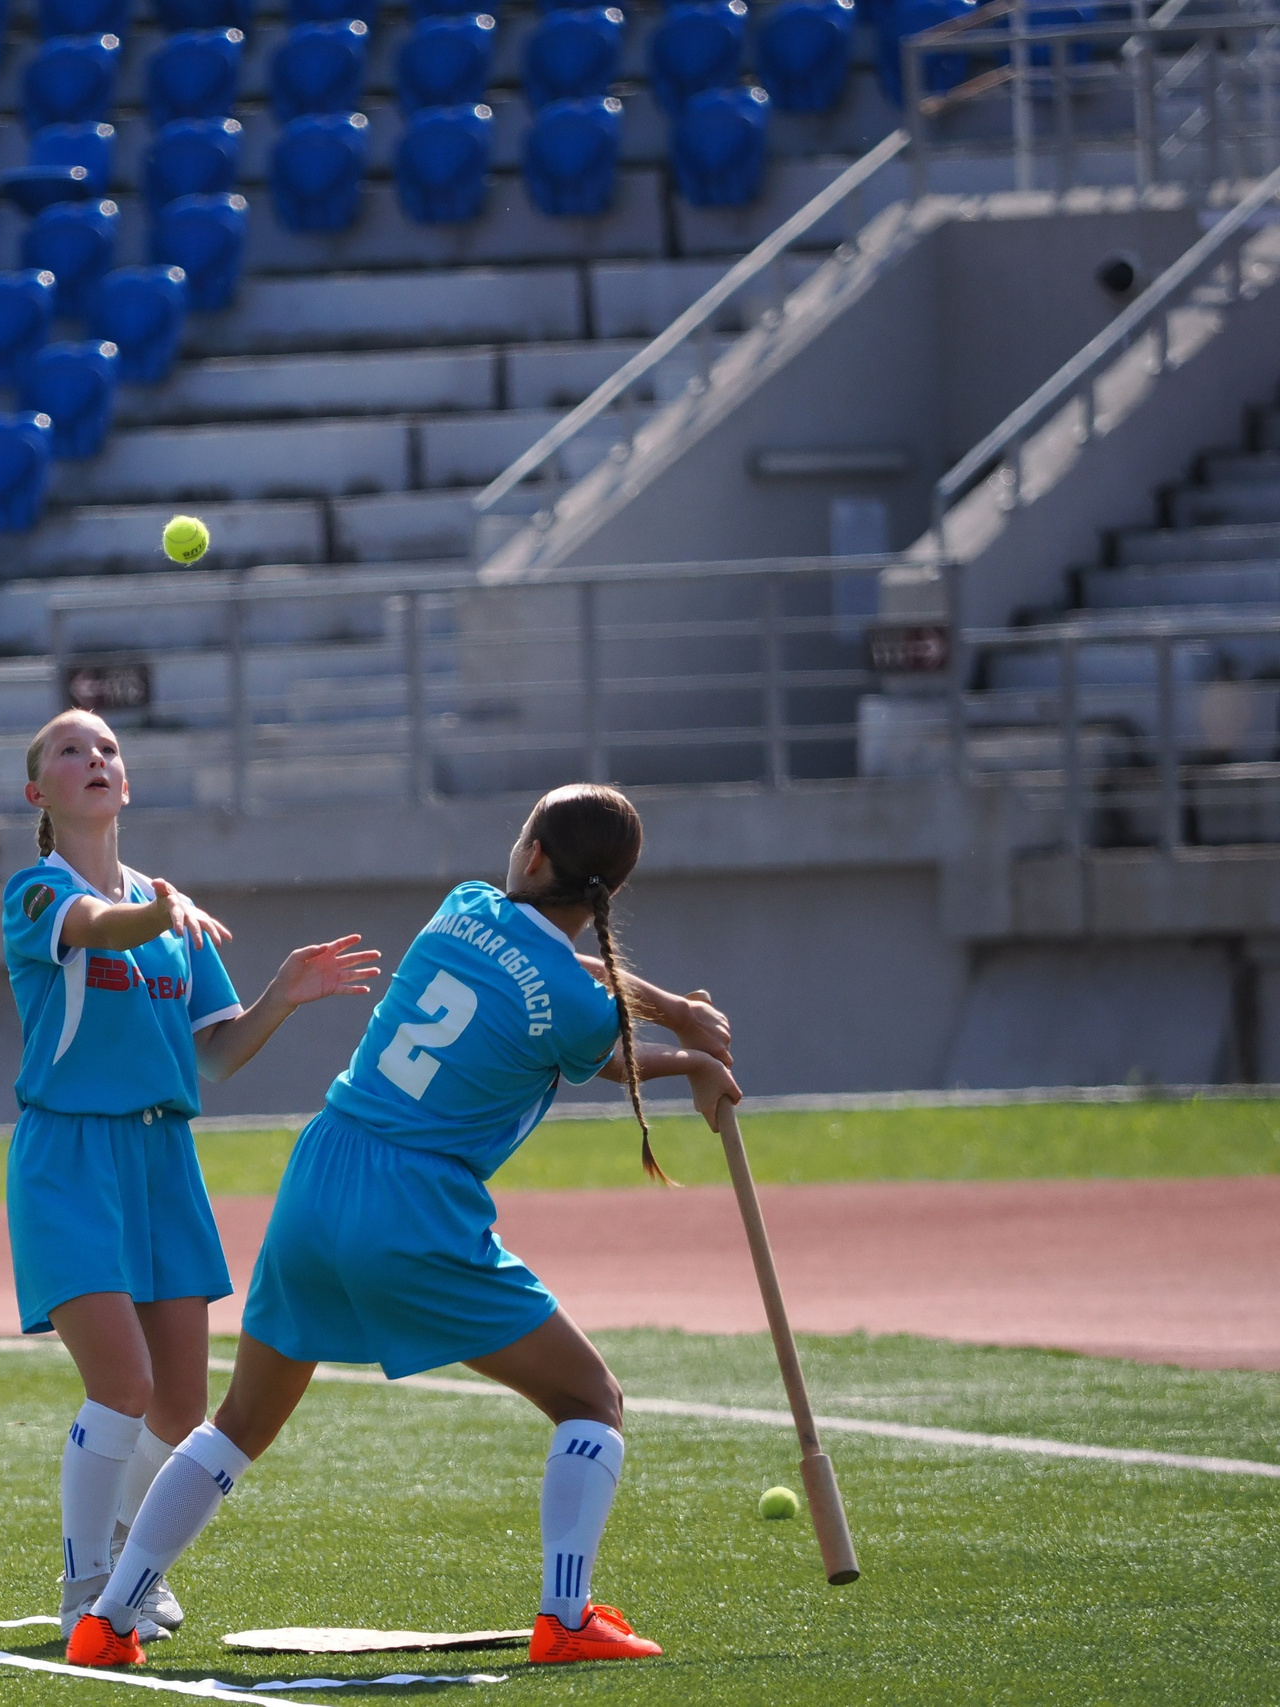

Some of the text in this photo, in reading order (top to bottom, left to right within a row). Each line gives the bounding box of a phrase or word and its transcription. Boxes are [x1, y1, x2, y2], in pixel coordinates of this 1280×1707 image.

[377, 969, 478, 1101] 2
[420, 913, 553, 1036] ОМСКАЯ ОБЛАСТЬ
